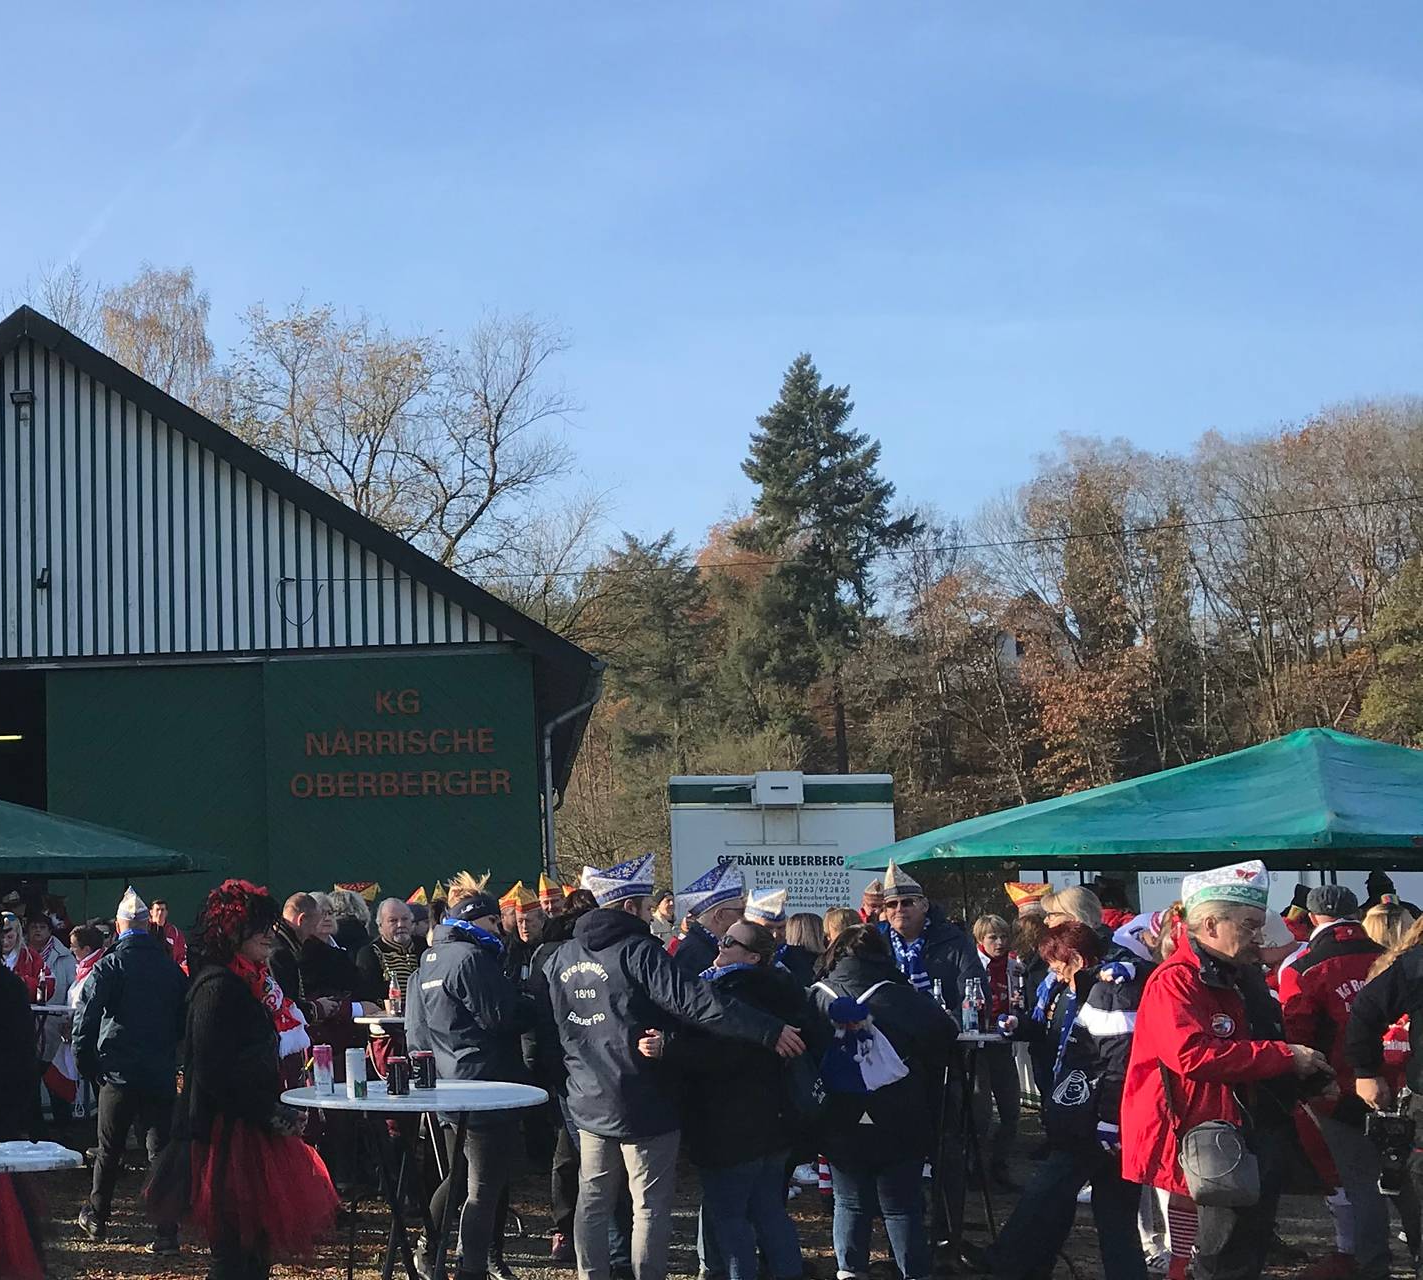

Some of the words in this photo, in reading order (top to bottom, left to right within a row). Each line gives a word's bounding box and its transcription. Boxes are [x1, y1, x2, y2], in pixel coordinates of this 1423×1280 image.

[375, 689, 420, 714] KG
[290, 769, 512, 798] OBERBERGER
[778, 855, 845, 866] UEBERBERG
[560, 961, 609, 983] Dreigestirn
[567, 1011, 593, 1026] Bauer
